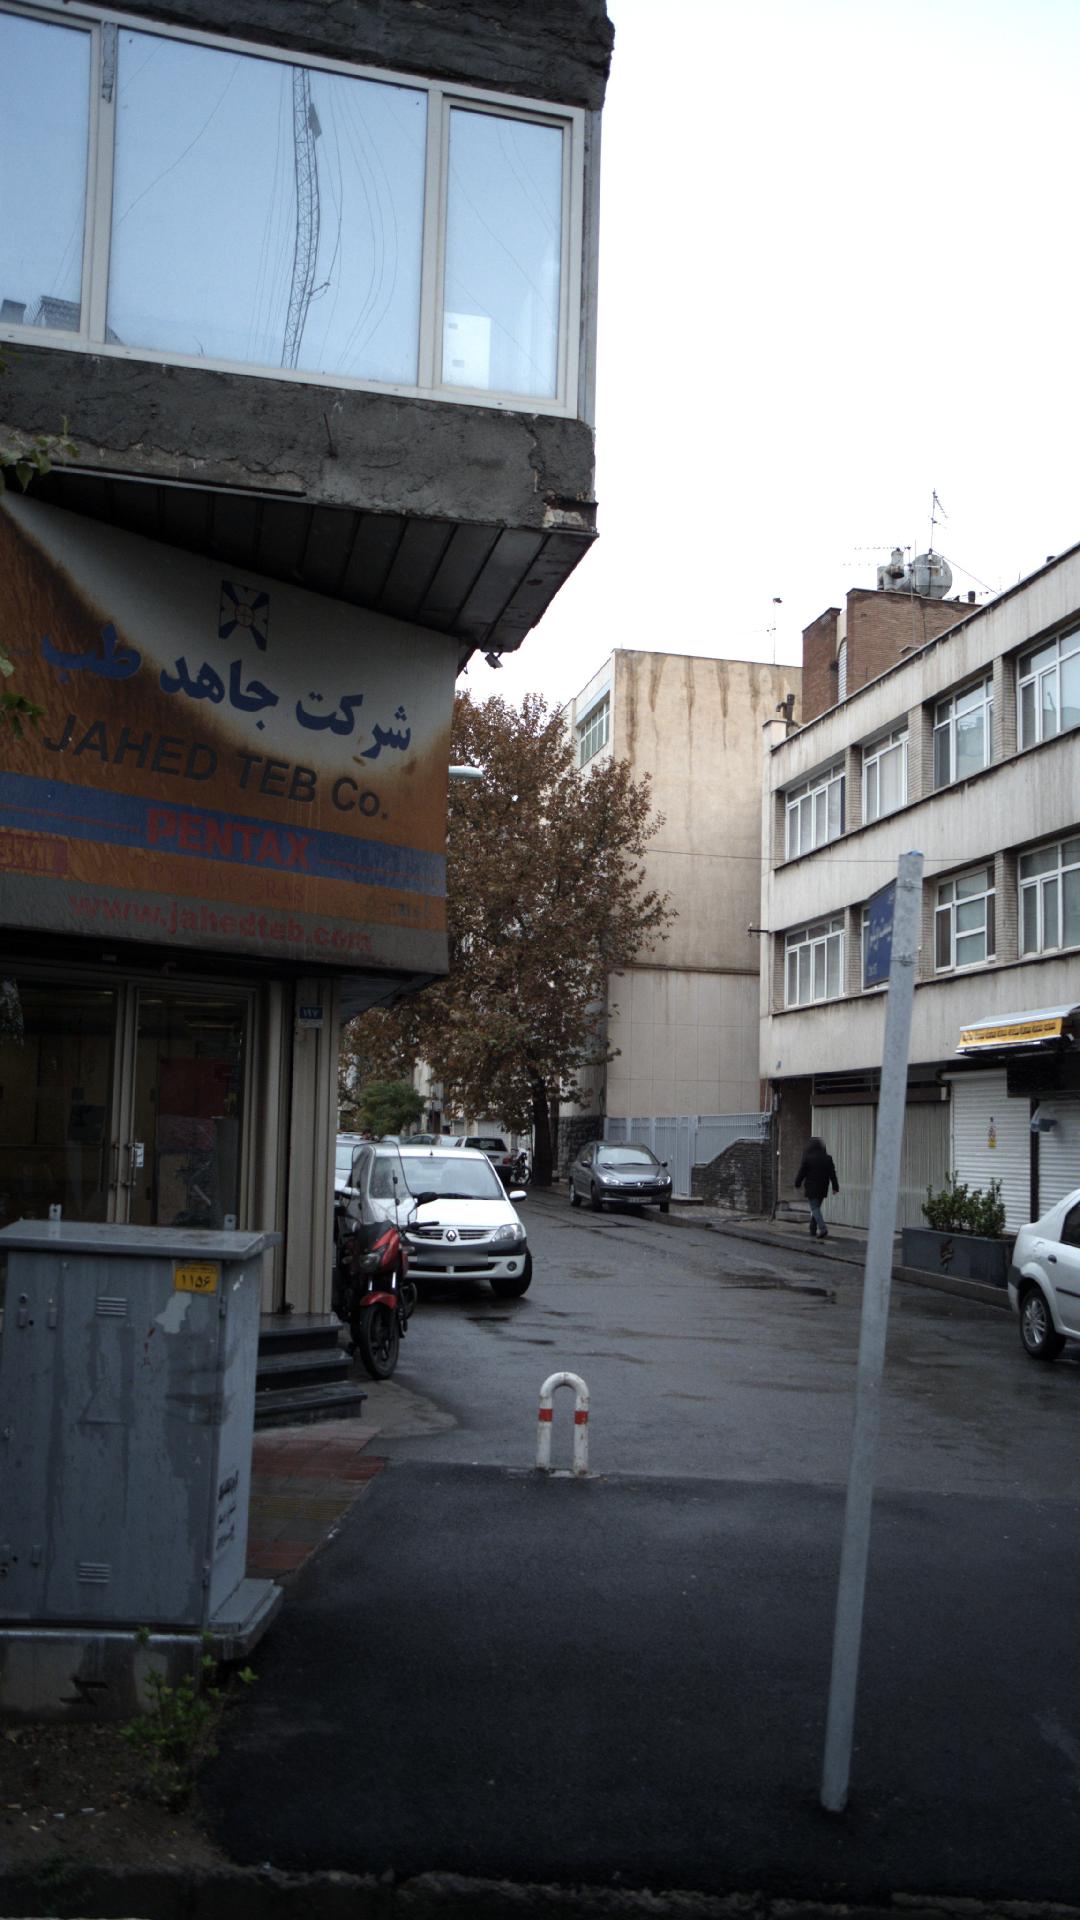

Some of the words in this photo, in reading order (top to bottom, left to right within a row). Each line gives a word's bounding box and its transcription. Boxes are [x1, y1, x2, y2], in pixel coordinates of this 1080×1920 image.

[41, 624, 143, 684] طب
[160, 656, 280, 731] جاهد
[296, 692, 412, 759] شرکت
[43, 713, 219, 781] JAHED
[237, 755, 319, 803] TEB
[331, 776, 389, 820] Co.
[145, 807, 312, 871] PENTAX
[69, 895, 372, 953] www.jahedteb.com
